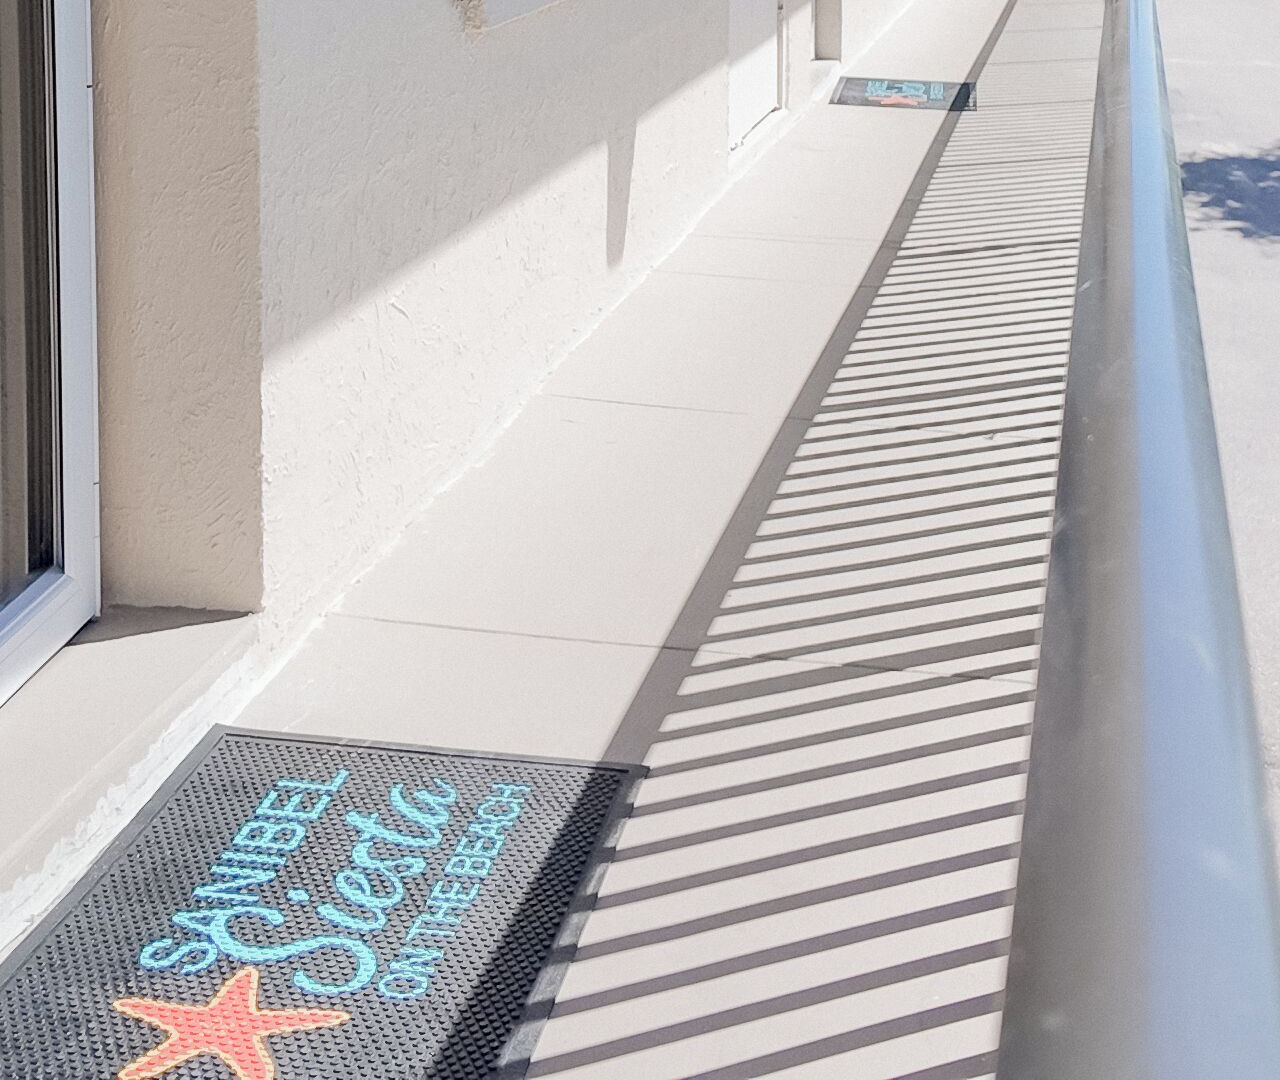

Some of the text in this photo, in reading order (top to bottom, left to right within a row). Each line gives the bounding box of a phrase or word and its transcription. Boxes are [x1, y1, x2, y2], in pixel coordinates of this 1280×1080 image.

[138, 768, 350, 976] SANIBEL
[208, 777, 458, 996] Siesta
[377, 781, 532, 1000] ON THE BEACH
